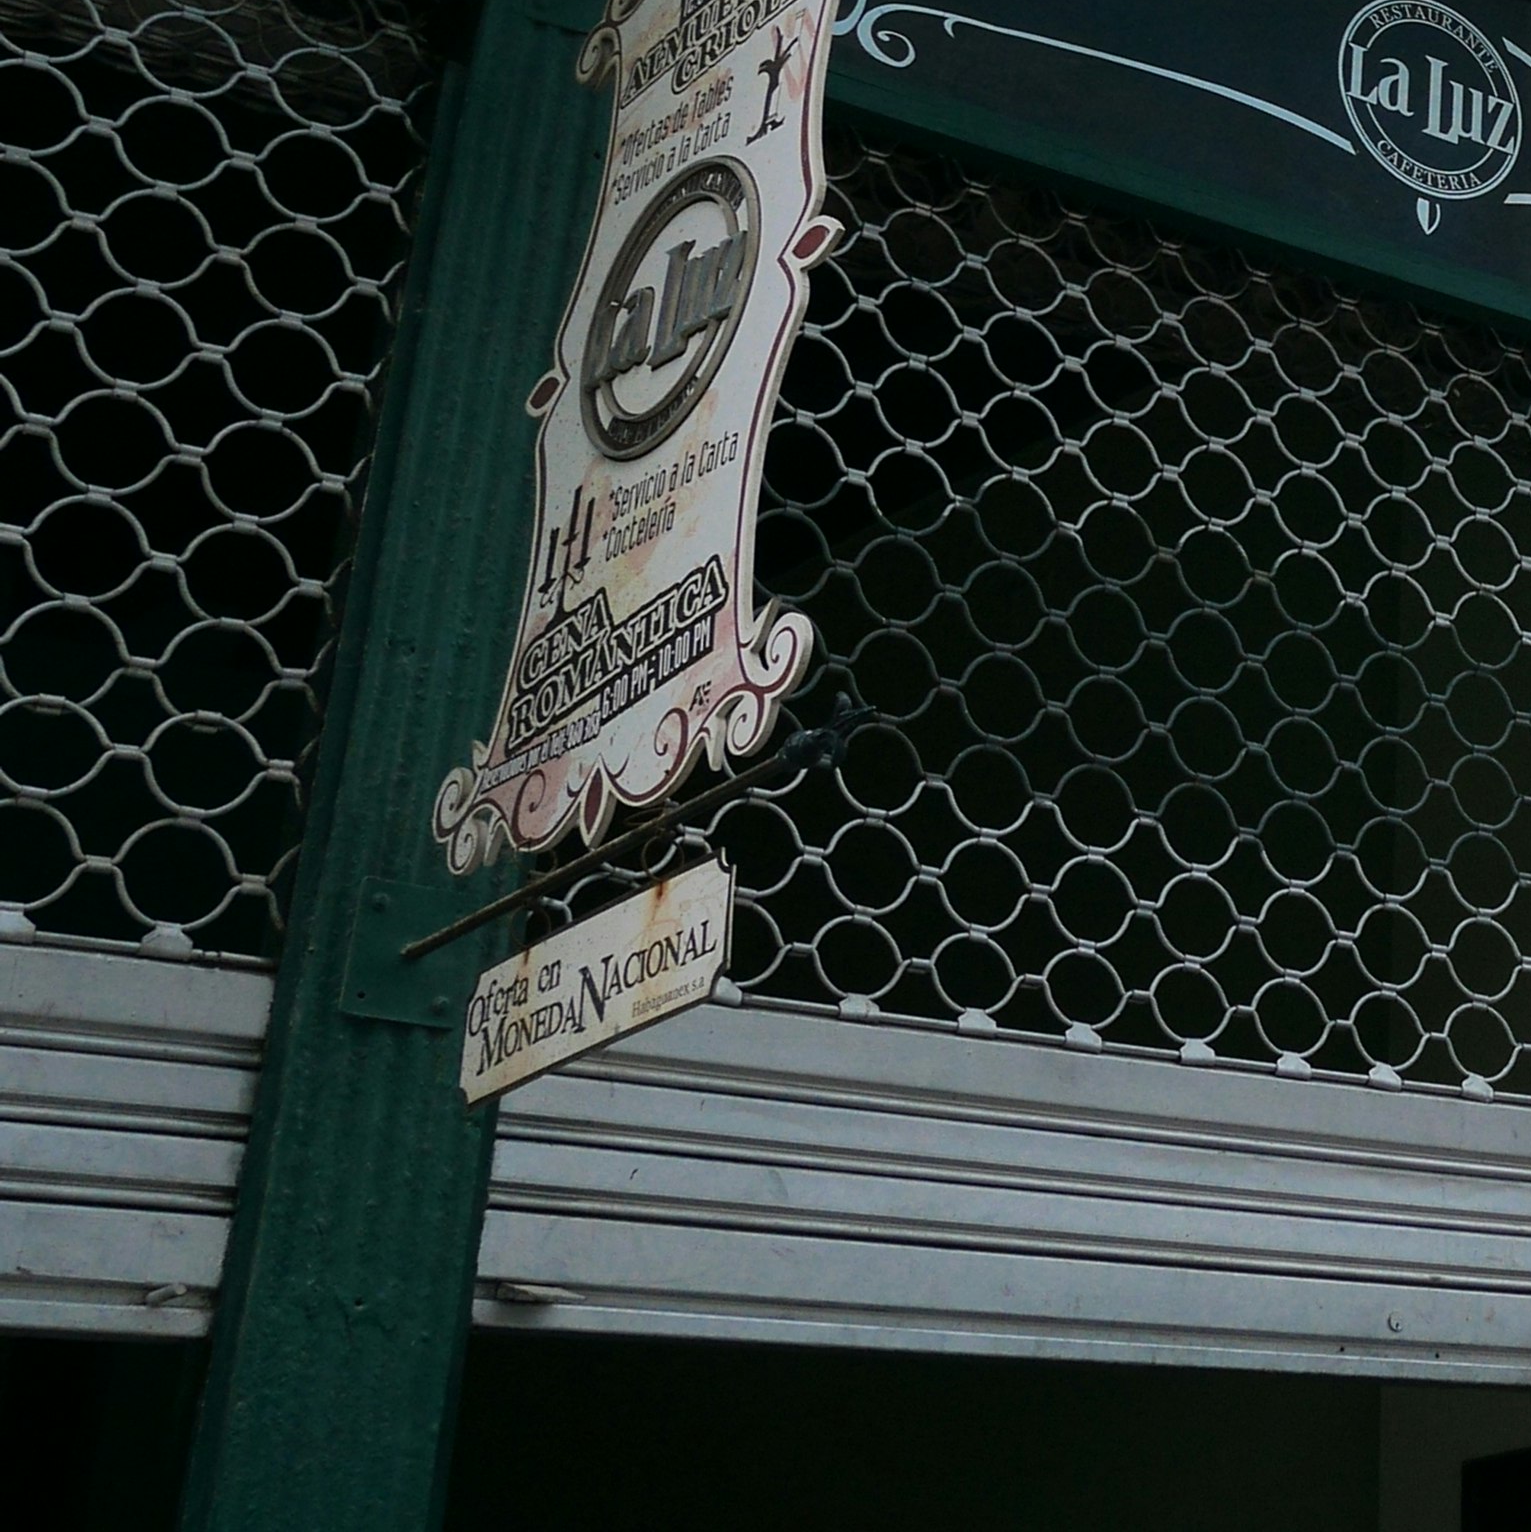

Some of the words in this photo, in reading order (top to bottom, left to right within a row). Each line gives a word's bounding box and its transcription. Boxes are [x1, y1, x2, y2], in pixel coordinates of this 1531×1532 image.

[1369, 4, 1498, 74] RESTAURANTE
[672, 101, 689, 134] de
[1346, 42, 1414, 117] La
[1421, 55, 1515, 155] Luz
[666, 146, 676, 172] a
[678, 135, 692, 166] la
[693, 112, 731, 155] Carta
[1377, 139, 1483, 190] CAFETERIA
[669, 462, 679, 492] a
[680, 451, 695, 486] la
[698, 431, 739, 477] Carta
[518, 589, 613, 691] CENA
[602, 673, 628, 719] 6:00
[630, 661, 649, 699] PM
[658, 630, 689, 681] 10:00
[691, 616, 712, 657] PM
[468, 975, 529, 1037] Oferta
[538, 959, 562, 994] en
[476, 996, 580, 1076] MONEDA
[575, 920, 718, 1034] NACIONAL
